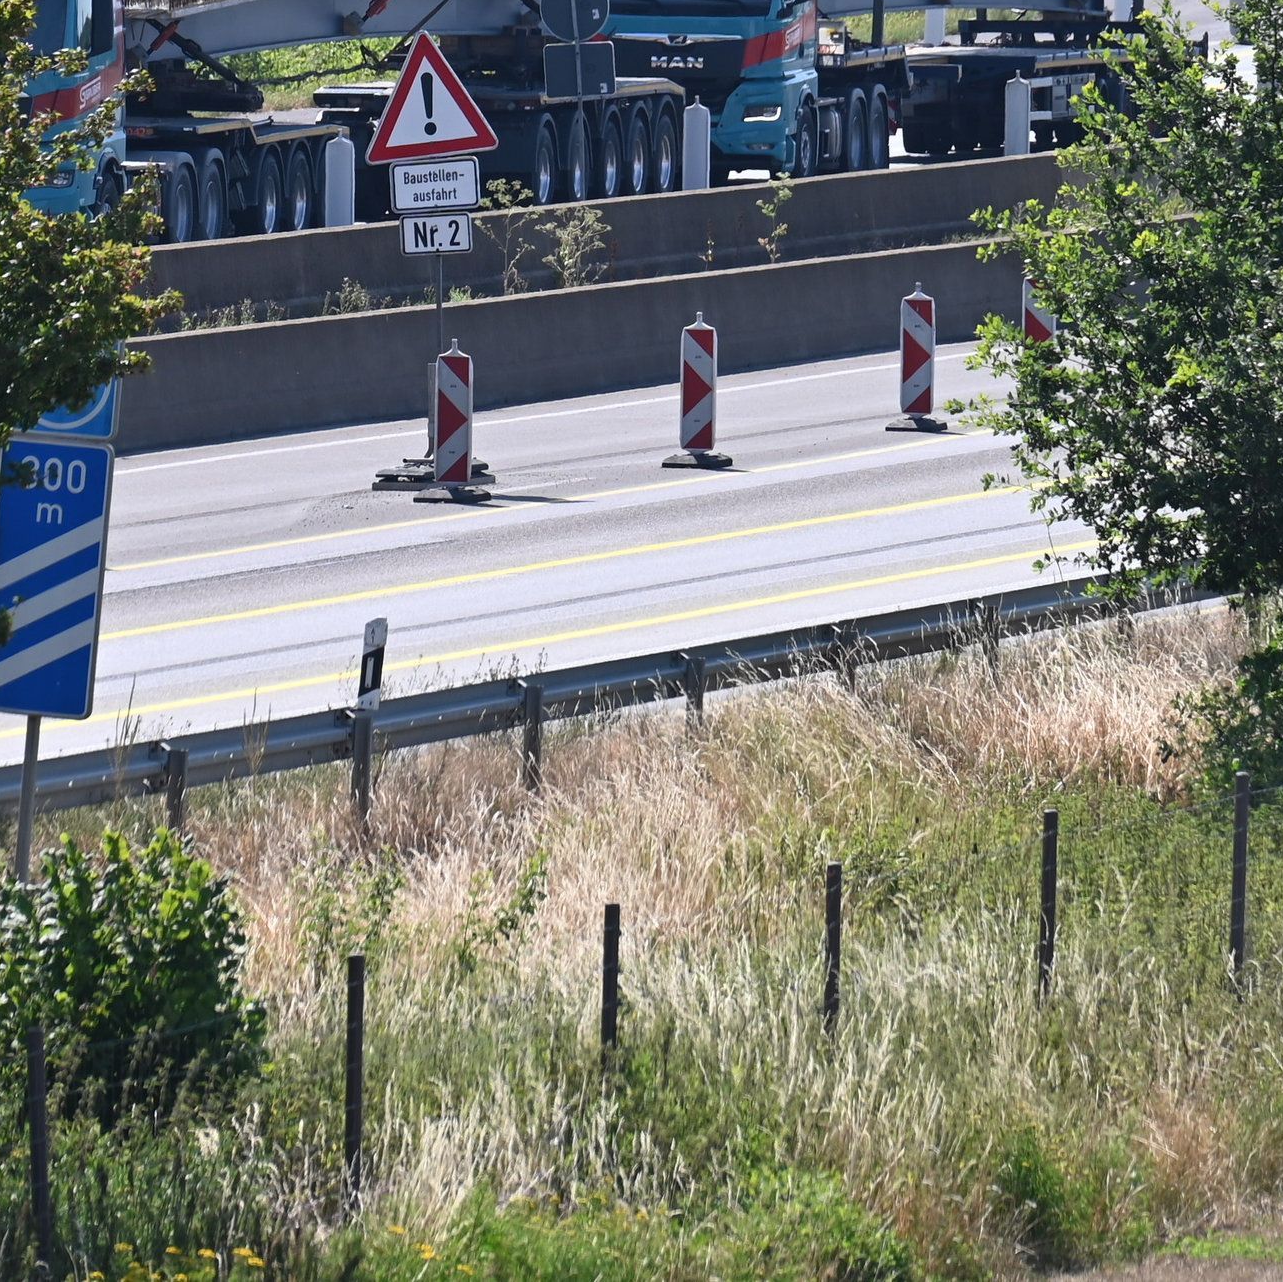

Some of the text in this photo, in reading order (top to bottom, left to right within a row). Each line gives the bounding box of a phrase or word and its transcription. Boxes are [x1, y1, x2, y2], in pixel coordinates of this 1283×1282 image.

[650, 56, 704, 68] MAN
[403, 168, 465, 185] Baustellen-
[413, 187, 457, 203] ausfahrt
[413, 219, 461, 248] Nr. 2
[36, 502, 63, 525] m
